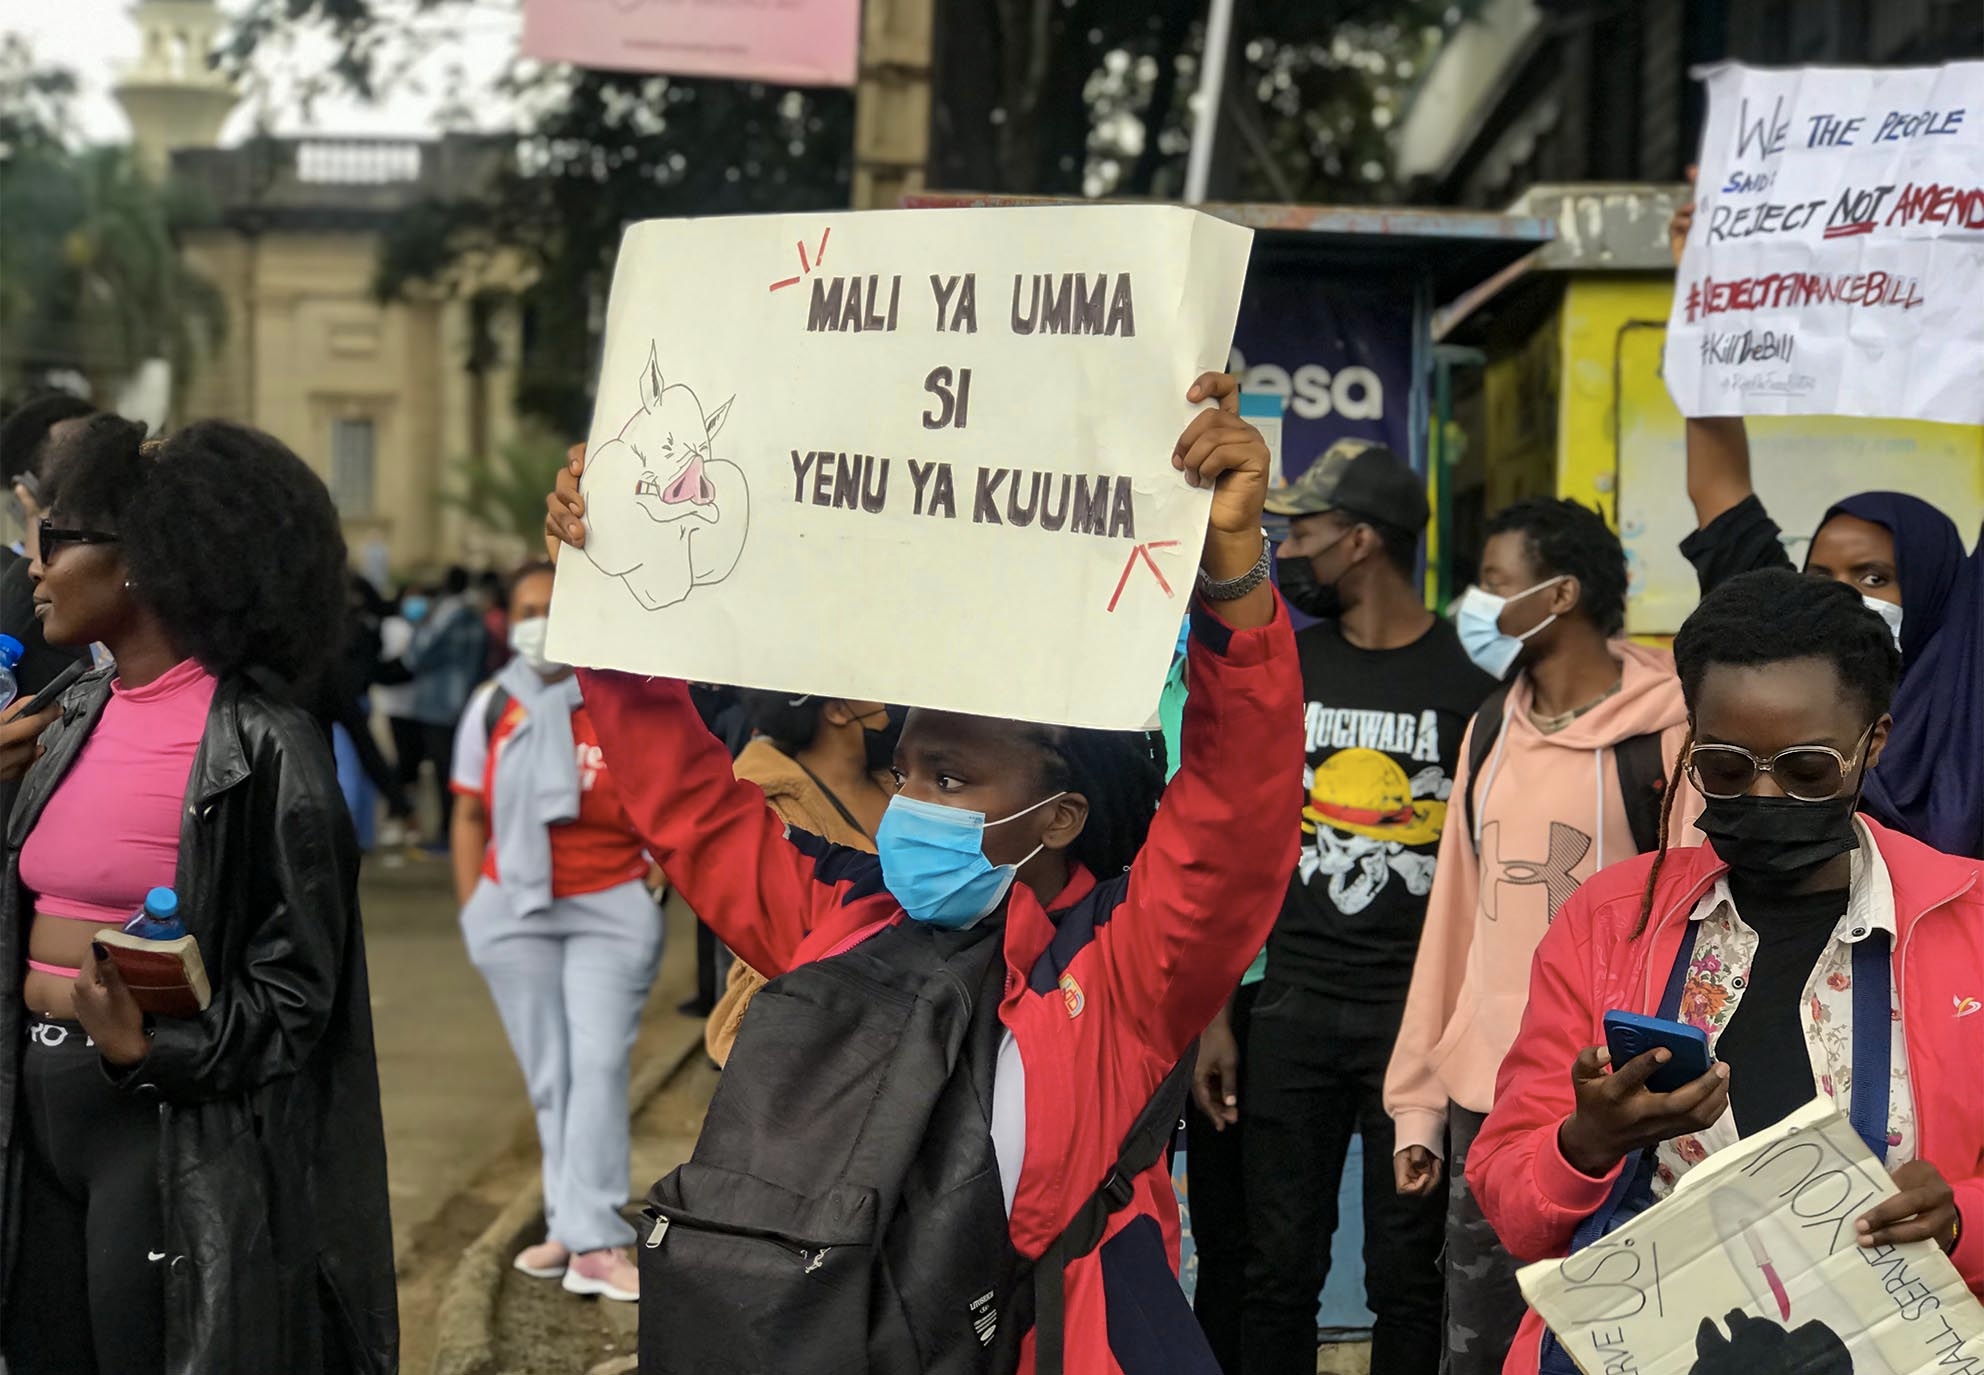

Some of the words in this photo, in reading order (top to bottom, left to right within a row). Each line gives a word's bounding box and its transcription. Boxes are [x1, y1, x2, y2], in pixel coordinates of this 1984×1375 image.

[1737, 95, 1790, 160] WE
[1807, 114, 1866, 148] THE
[1872, 109, 1966, 144] PEOPLE
[1827, 185, 1895, 227] NOT
[807, 274, 901, 332] MALI
[930, 273, 978, 333] YA
[1010, 272, 1136, 337] UMMA
[922, 365, 972, 429] SI
[791, 450, 890, 513] YENU
[907, 458, 956, 518] YA
[972, 466, 1135, 539] KUUMA
